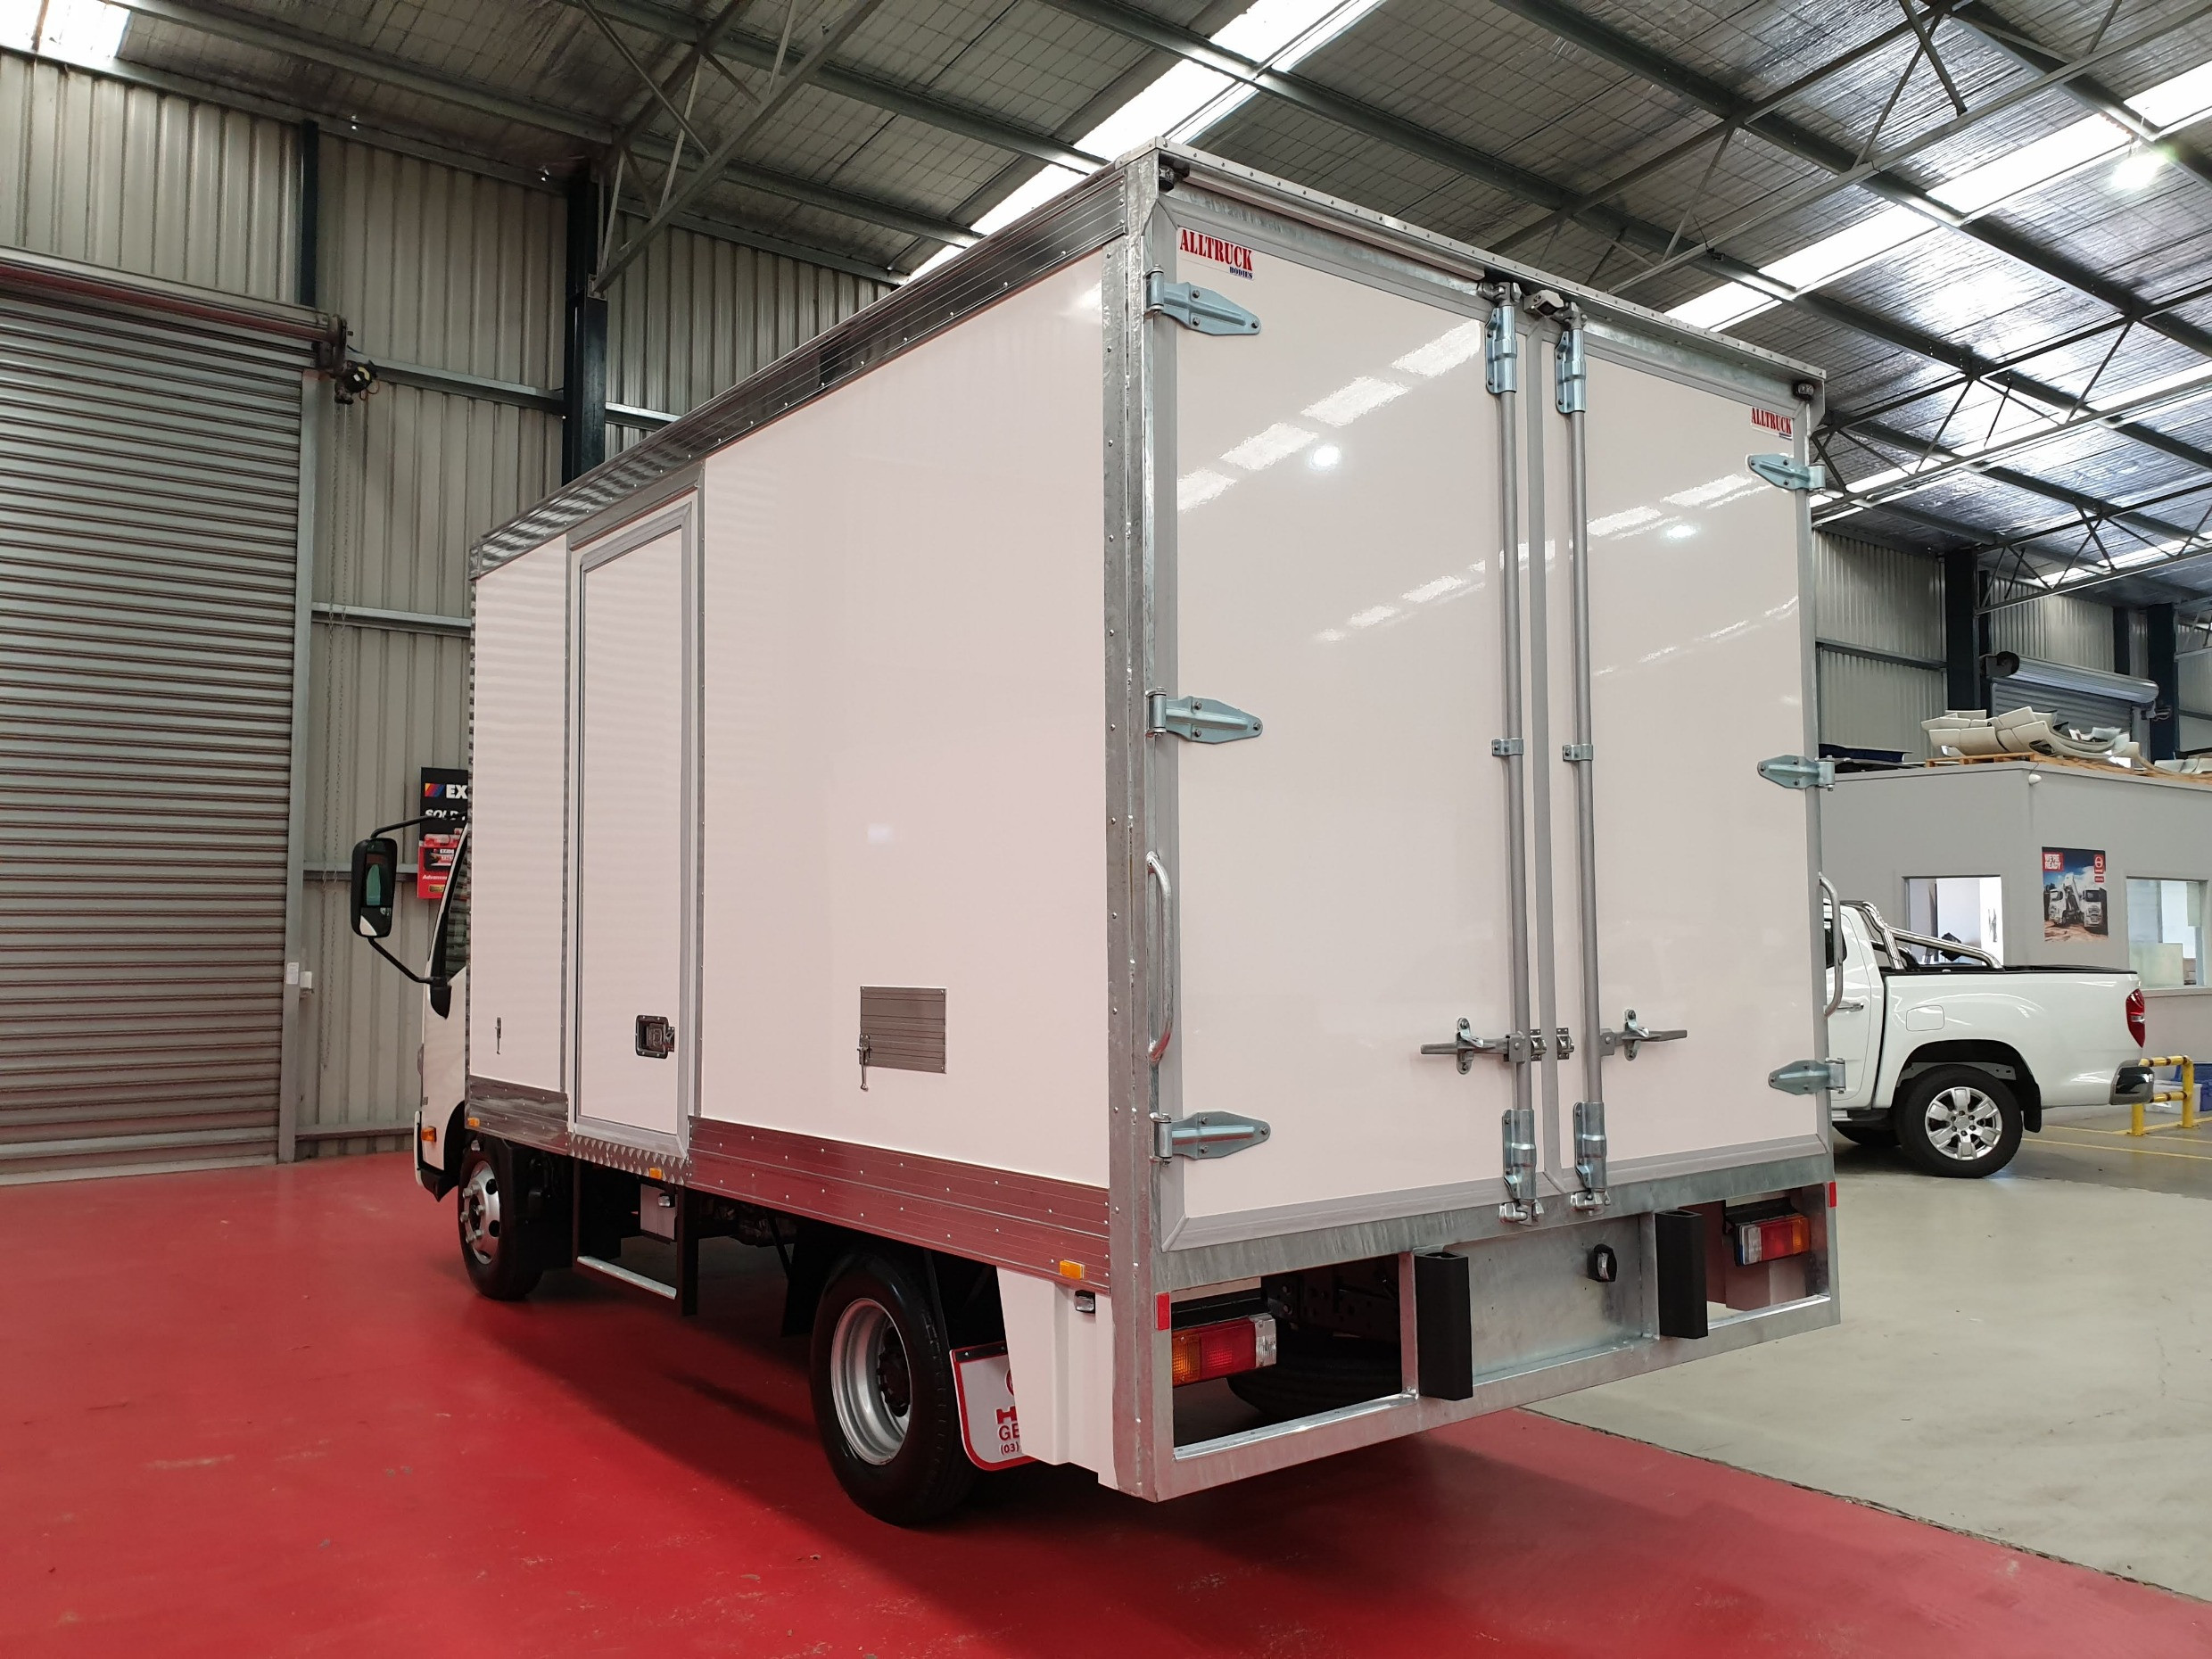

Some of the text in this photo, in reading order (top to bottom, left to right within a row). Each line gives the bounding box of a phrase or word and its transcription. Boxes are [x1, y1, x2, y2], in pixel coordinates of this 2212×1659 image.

[1180, 229, 1253, 271] ALLTRUCK
[1230, 267, 1253, 280] BODIES
[1751, 408, 1792, 434] ALLTRUCK
[446, 784, 468, 799] EX
[1001, 1440, 1019, 1456] (03)
